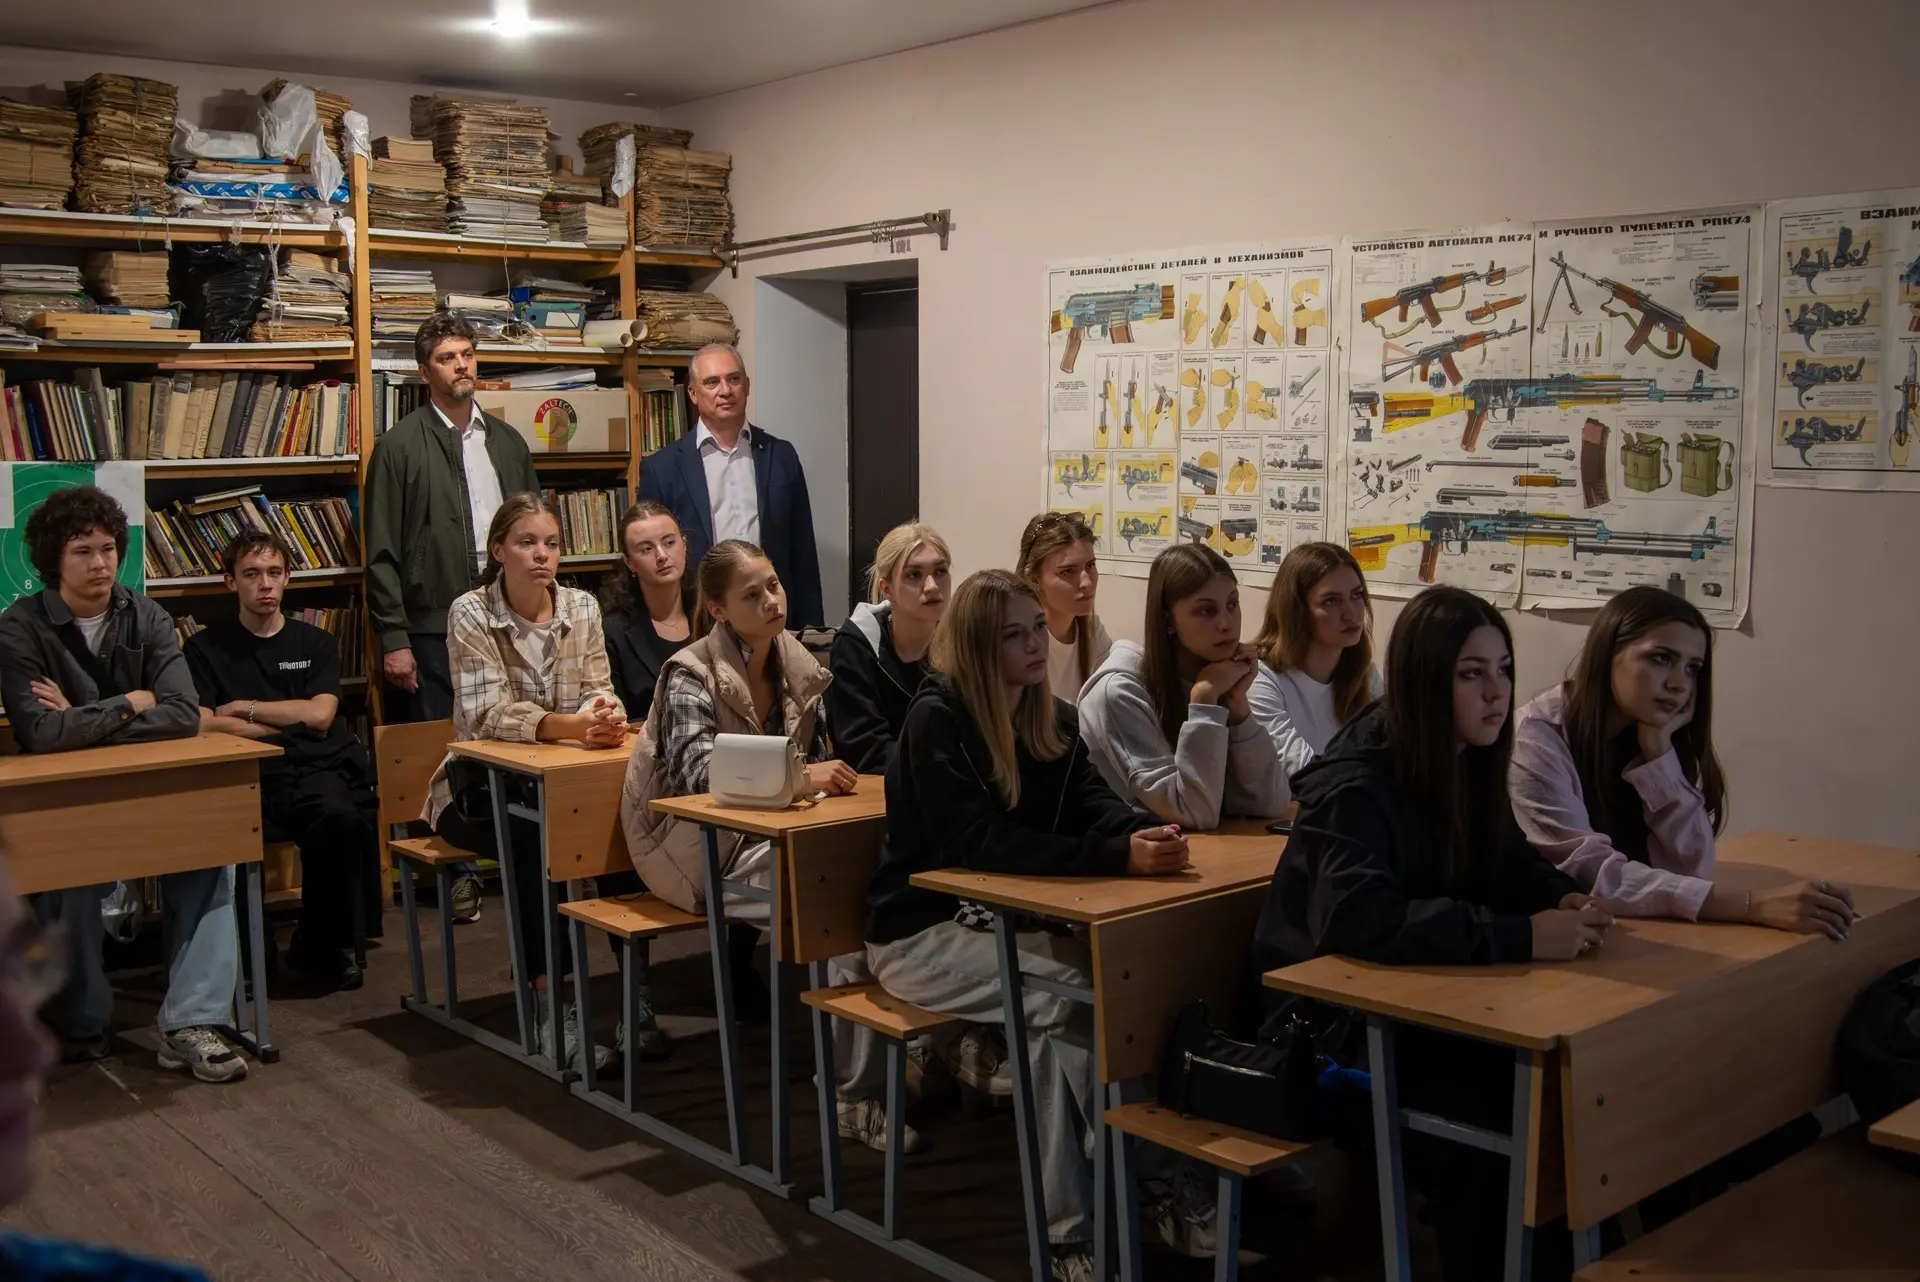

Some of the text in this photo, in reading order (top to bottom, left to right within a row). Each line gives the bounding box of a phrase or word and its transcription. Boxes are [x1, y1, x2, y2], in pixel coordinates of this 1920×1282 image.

[1352, 215, 1751, 253] УСТРОЙСТВО АВТОМАТА АК74 И РУЧНОГО ПУЛЕМЕТА РПК74
[1069, 250, 1304, 277] ВЗАИМОДЕЙСТВИЕ ДЕТАЛЕЙ И МЕХАНИЗМОВ
[538, 399, 574, 415] ZALTECH
[24, 579, 33, 590] 8
